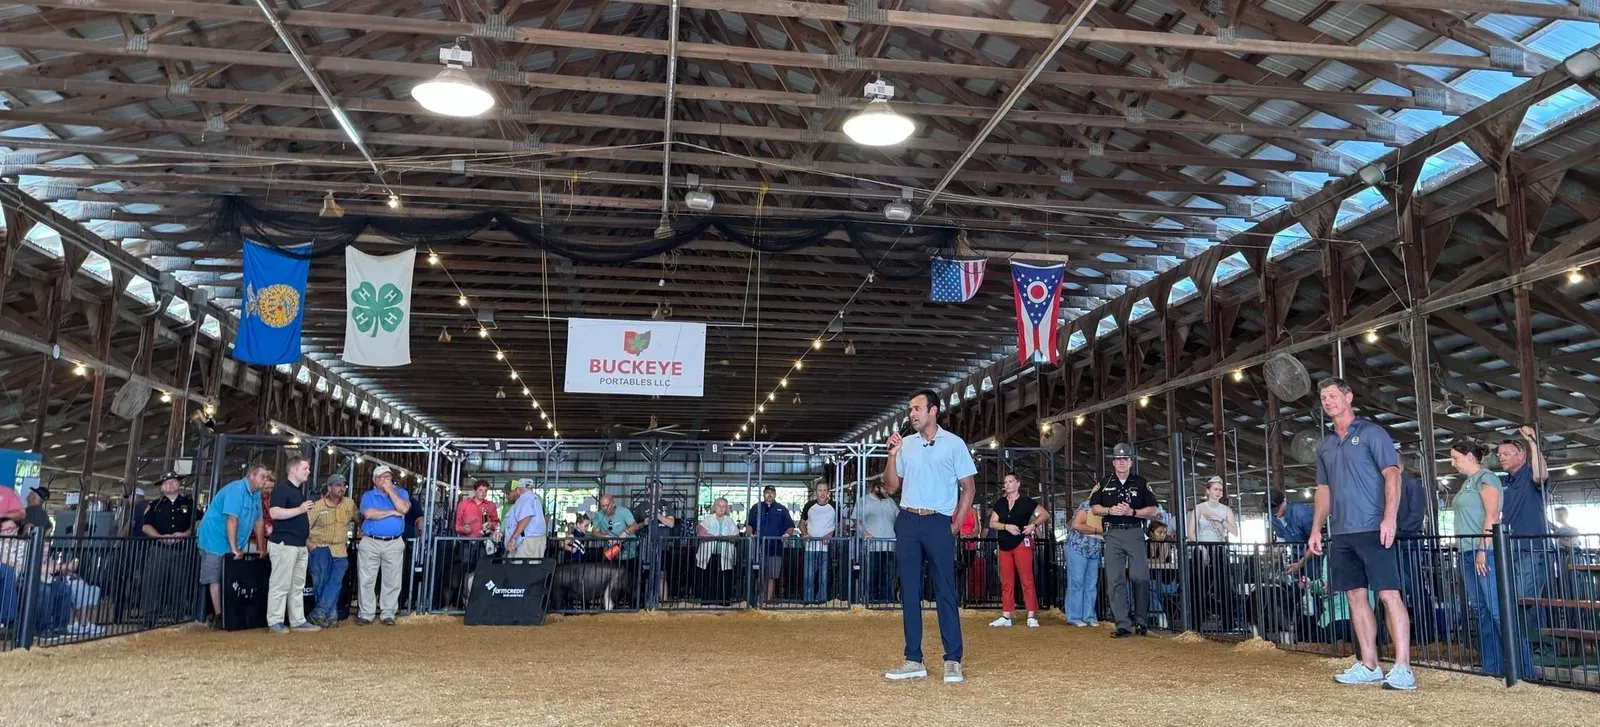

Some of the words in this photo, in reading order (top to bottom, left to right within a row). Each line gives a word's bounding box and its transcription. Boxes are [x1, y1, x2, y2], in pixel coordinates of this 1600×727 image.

[359, 287, 370, 301] H
[384, 289, 397, 303] H
[356, 312, 369, 325] H
[384, 312, 398, 325] H
[589, 358, 683, 376] BUCKEYE
[599, 377, 652, 387] PORTABLES
[654, 379, 671, 387] LLC
